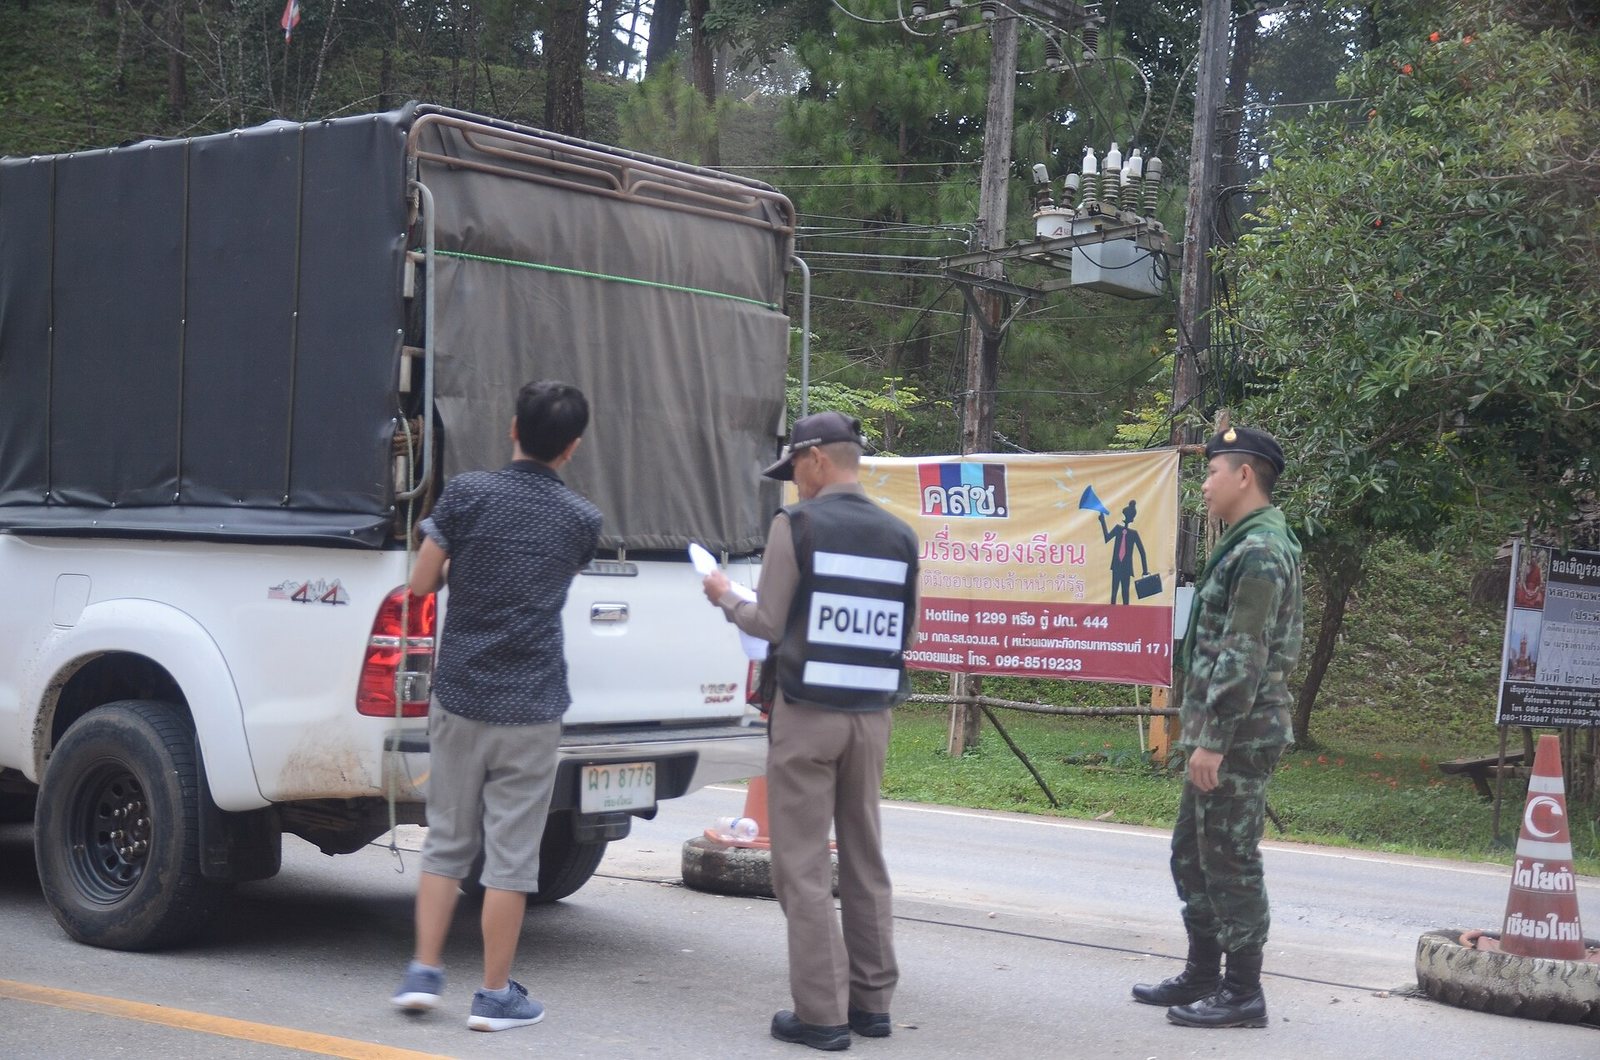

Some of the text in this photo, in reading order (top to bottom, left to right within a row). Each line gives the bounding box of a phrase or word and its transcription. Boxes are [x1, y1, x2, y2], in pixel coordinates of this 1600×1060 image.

[923, 484, 1006, 515] คสช.
[921, 568, 1086, 600] ติมิชอบของเจ้าหน้าที่รัฐ
[818, 605, 899, 638] POLICE
[925, 608, 1109, 630] Hotline 1299 หรือ ตู้ ปณ. 444
[968, 650, 991, 666] โทร.
[995, 654, 1082, 671] 096-8519233
[1146, 643, 1160, 654] 17
[618, 766, 653, 788] 8776
[1513, 860, 1574, 891] โตโยต้า
[1506, 912, 1580, 941] เชียงใหม่
